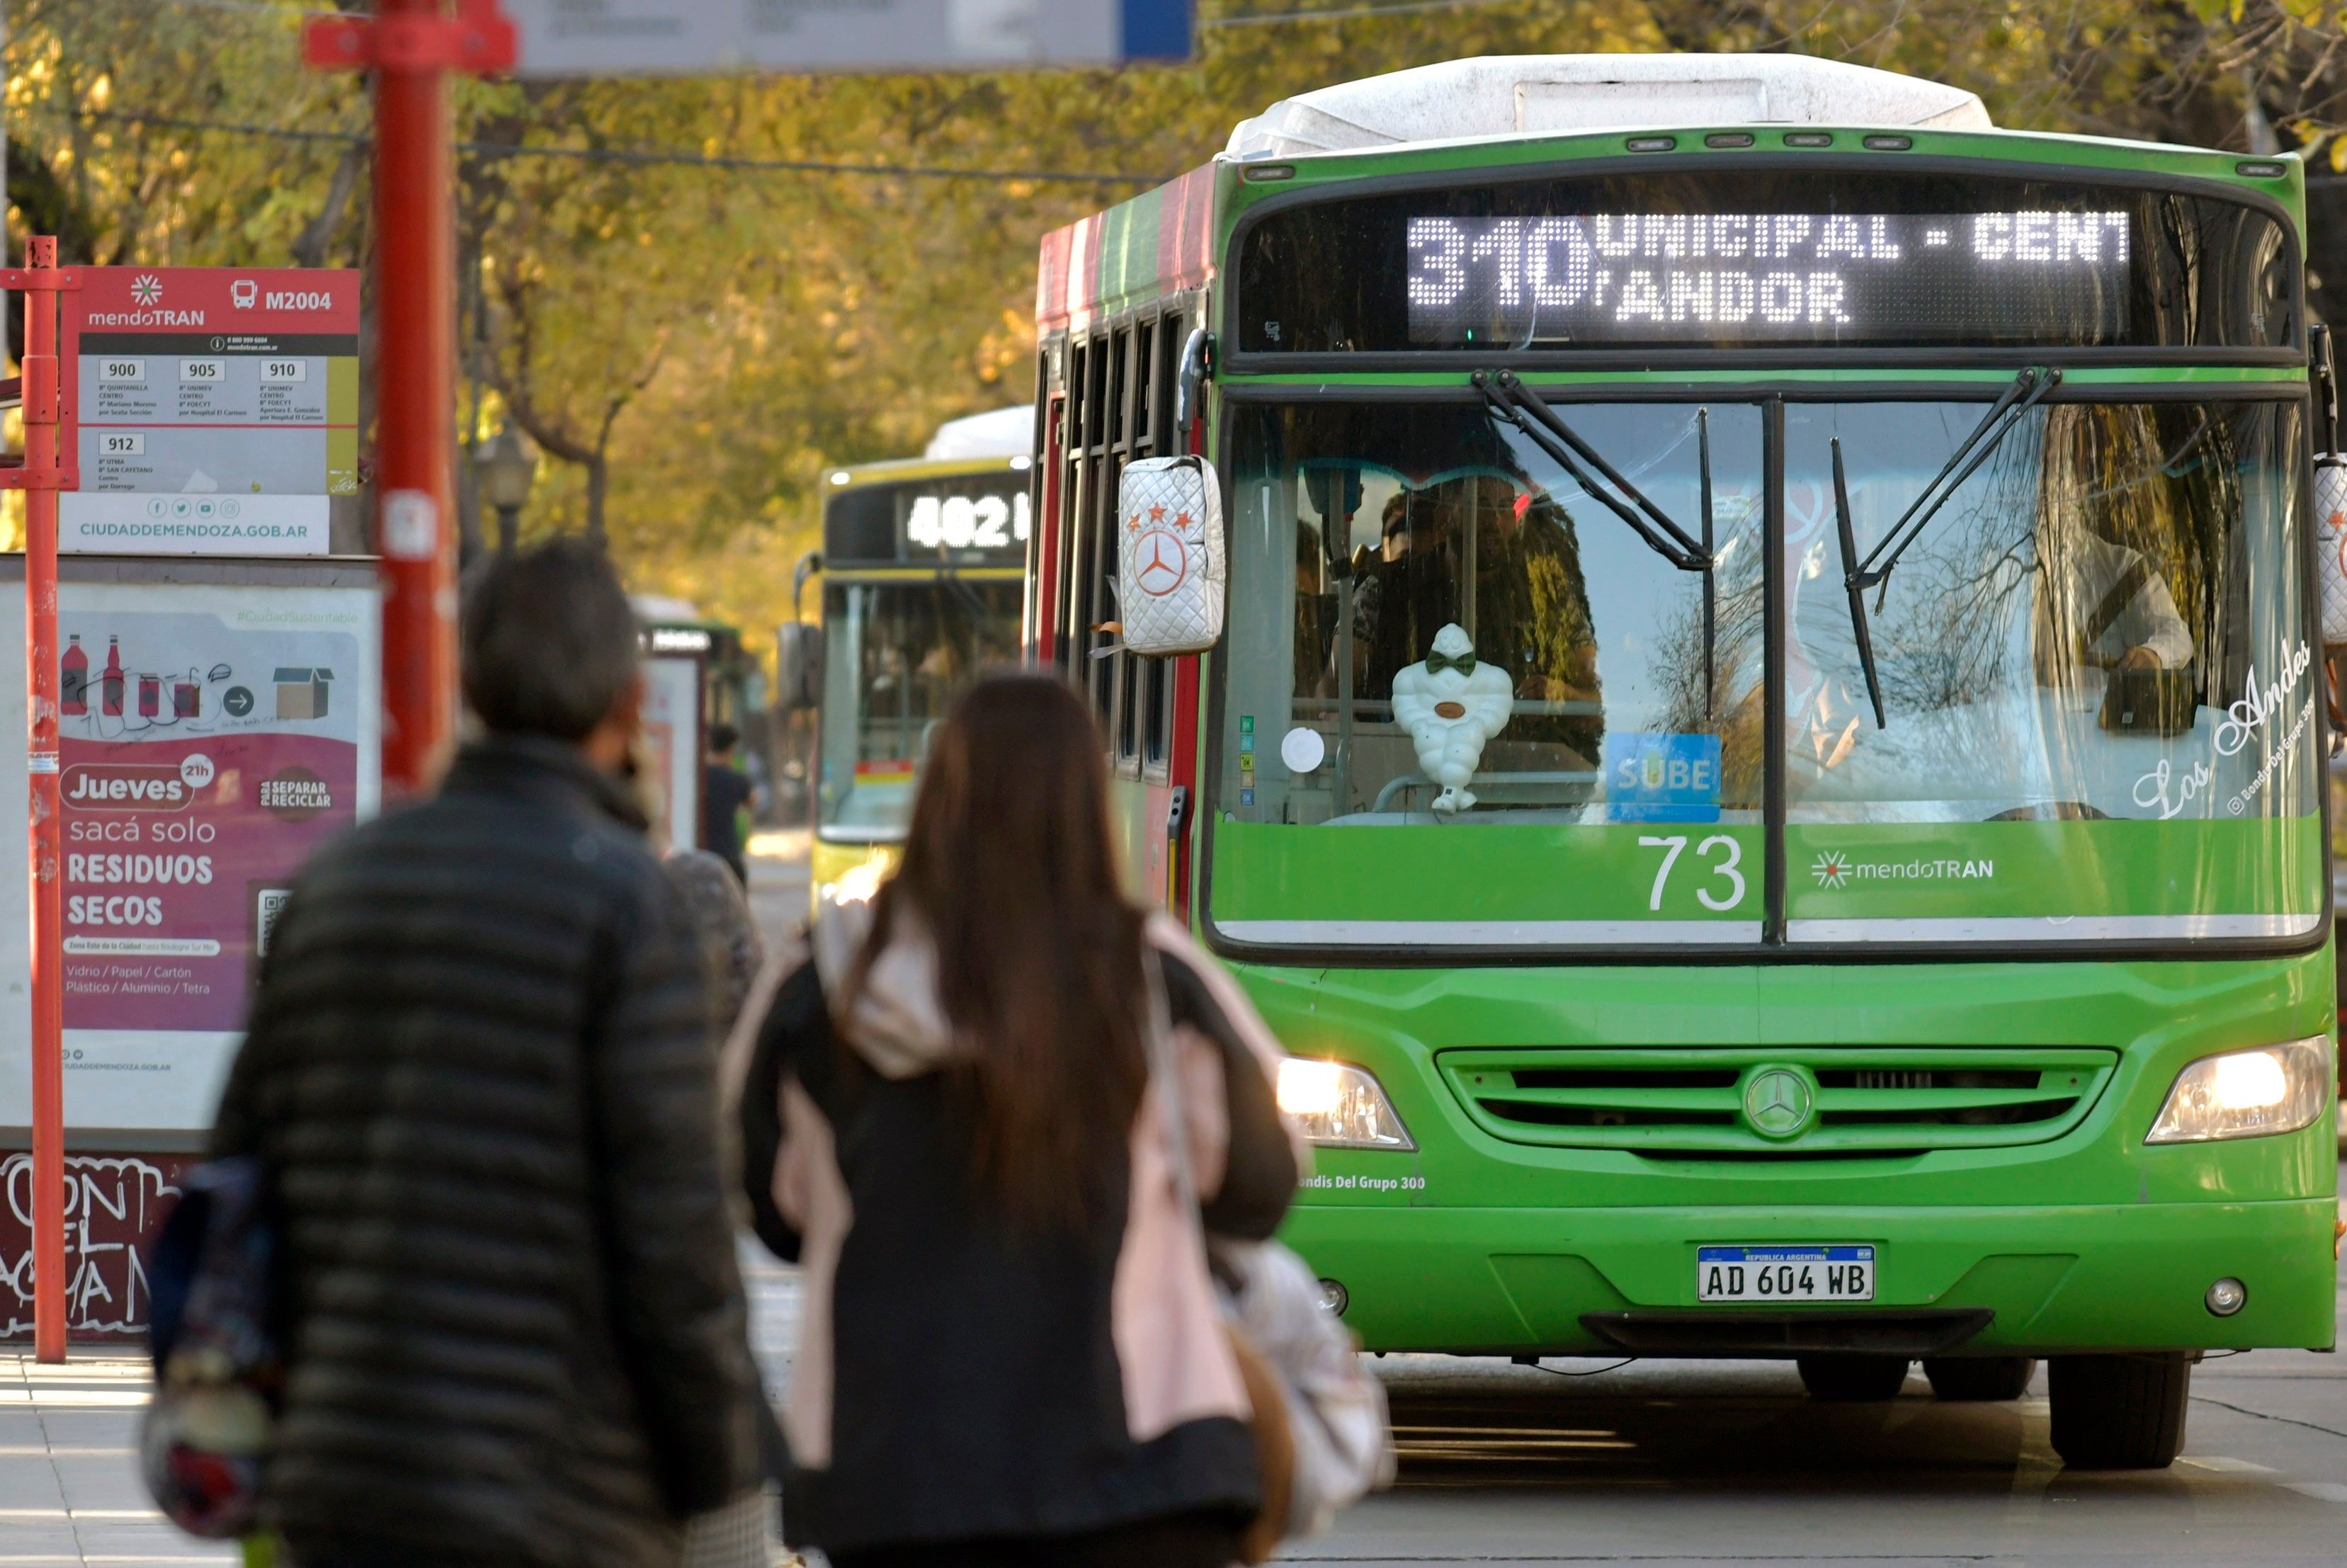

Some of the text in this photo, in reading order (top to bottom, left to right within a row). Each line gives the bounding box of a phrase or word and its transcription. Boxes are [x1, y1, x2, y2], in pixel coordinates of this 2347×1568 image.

[1409, 220, 1589, 305] 310
[1596, 214, 1899, 258] UNICIPAL
[266, 292, 331, 309] M2004
[89, 309, 204, 326] mendoTRAN
[109, 363, 136, 377] 900
[189, 364, 215, 377] 905
[270, 363, 295, 377] 910
[108, 438, 133, 450] 912
[80, 523, 307, 538] CIUDADDEMENDOZA.GOB.AR
[2132, 638, 2311, 820] Los Andes
[186, 766, 209, 776] 21h
[1618, 757, 1711, 790] SUBE
[70, 773, 182, 800] Jueves
[272, 781, 326, 795] SEPARAR
[272, 794, 331, 807] RECICLAR
[70, 816, 216, 843] sacá solo
[68, 853, 212, 884] RESIDUOS
[1638, 834, 1746, 911] 73
[1857, 859, 1993, 880] mendoTRAN
[68, 895, 162, 926] SECOS
[67, 965, 100, 977] Vidrio
[112, 966, 142, 979] Papel
[154, 966, 191, 978] Cartón
[67, 981, 110, 992] Plástico
[121, 982, 171, 994] Aluminio
[182, 982, 210, 994] Tetra
[1298, 1176, 1425, 1192] ondis Del Grupo 300
[1707, 1265, 1865, 1295] AD 604 WB
